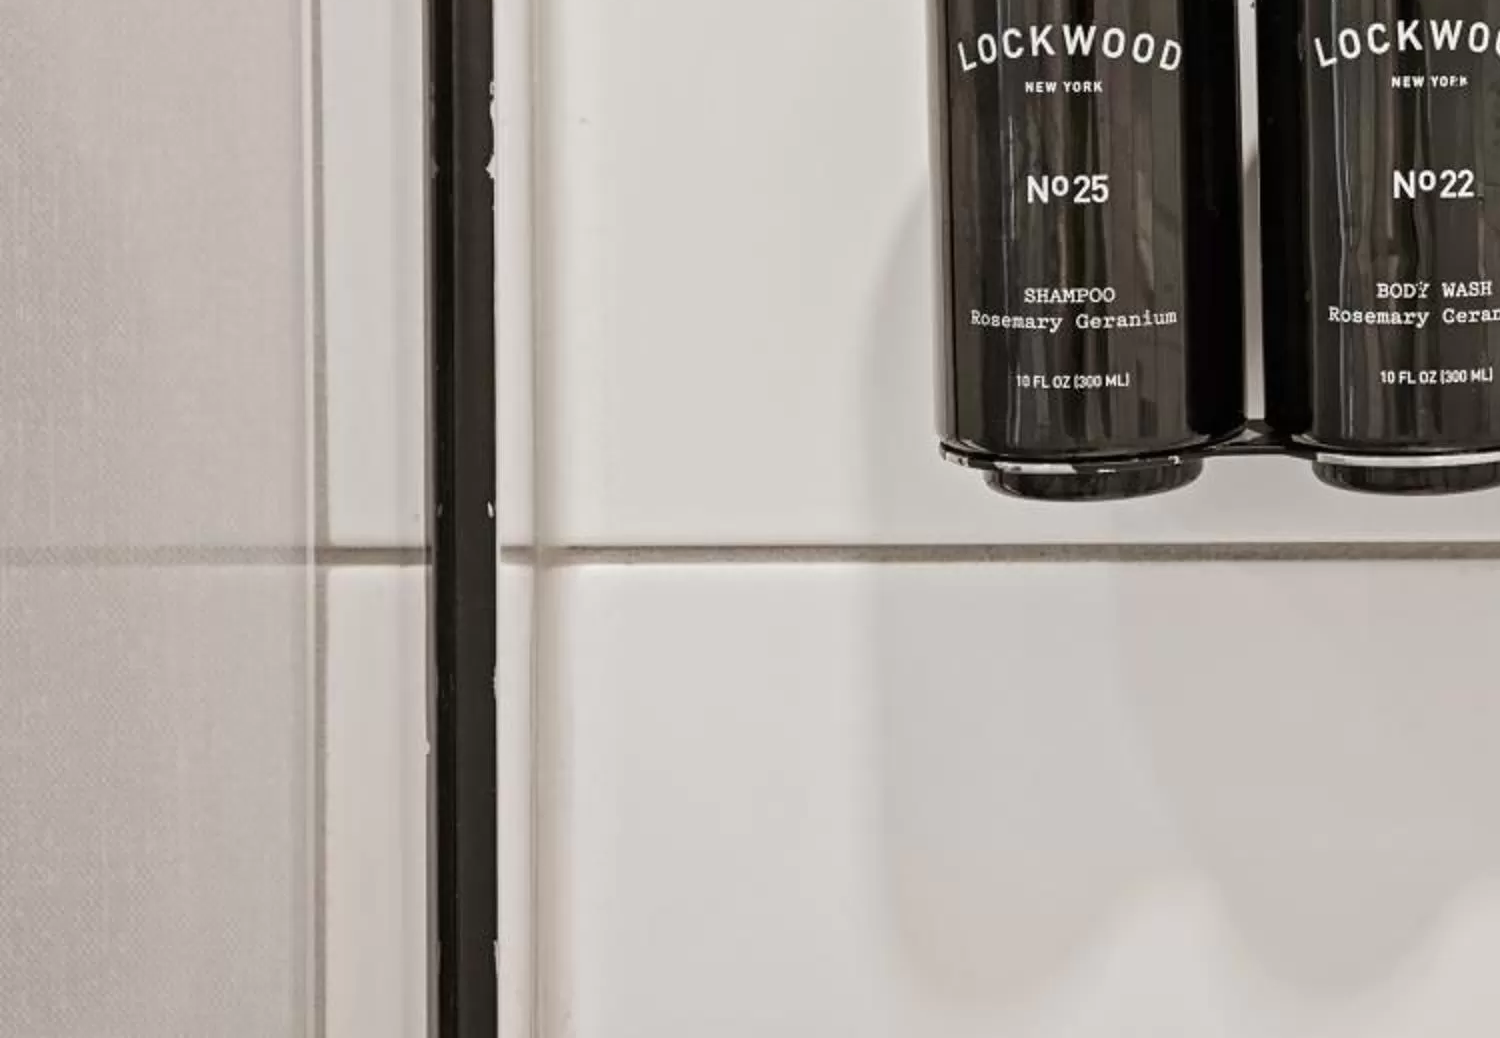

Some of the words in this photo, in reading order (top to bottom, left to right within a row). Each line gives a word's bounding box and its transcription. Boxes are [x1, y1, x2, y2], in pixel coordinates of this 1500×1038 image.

[958, 24, 1183, 71] LOCKWOOD
[1026, 82, 1056, 93] NEW
[1063, 82, 1103, 93] YORK
[1392, 76, 1424, 87] NEW
[1024, 288, 1116, 303] SHAMPOO
[1377, 283, 1430, 298] BODY
[1443, 281, 1492, 297] WASH
[971, 310, 1062, 333] Rosemary
[1076, 310, 1177, 329] Geranium
[1329, 306, 1429, 328] Rosemary
[1016, 375, 1030, 388] 10
[1034, 376, 1050, 388] FL
[1053, 376, 1071, 389] OZ
[1381, 370, 1395, 384] 10
[1399, 370, 1416, 384] FL
[1419, 370, 1437, 384] OZ
